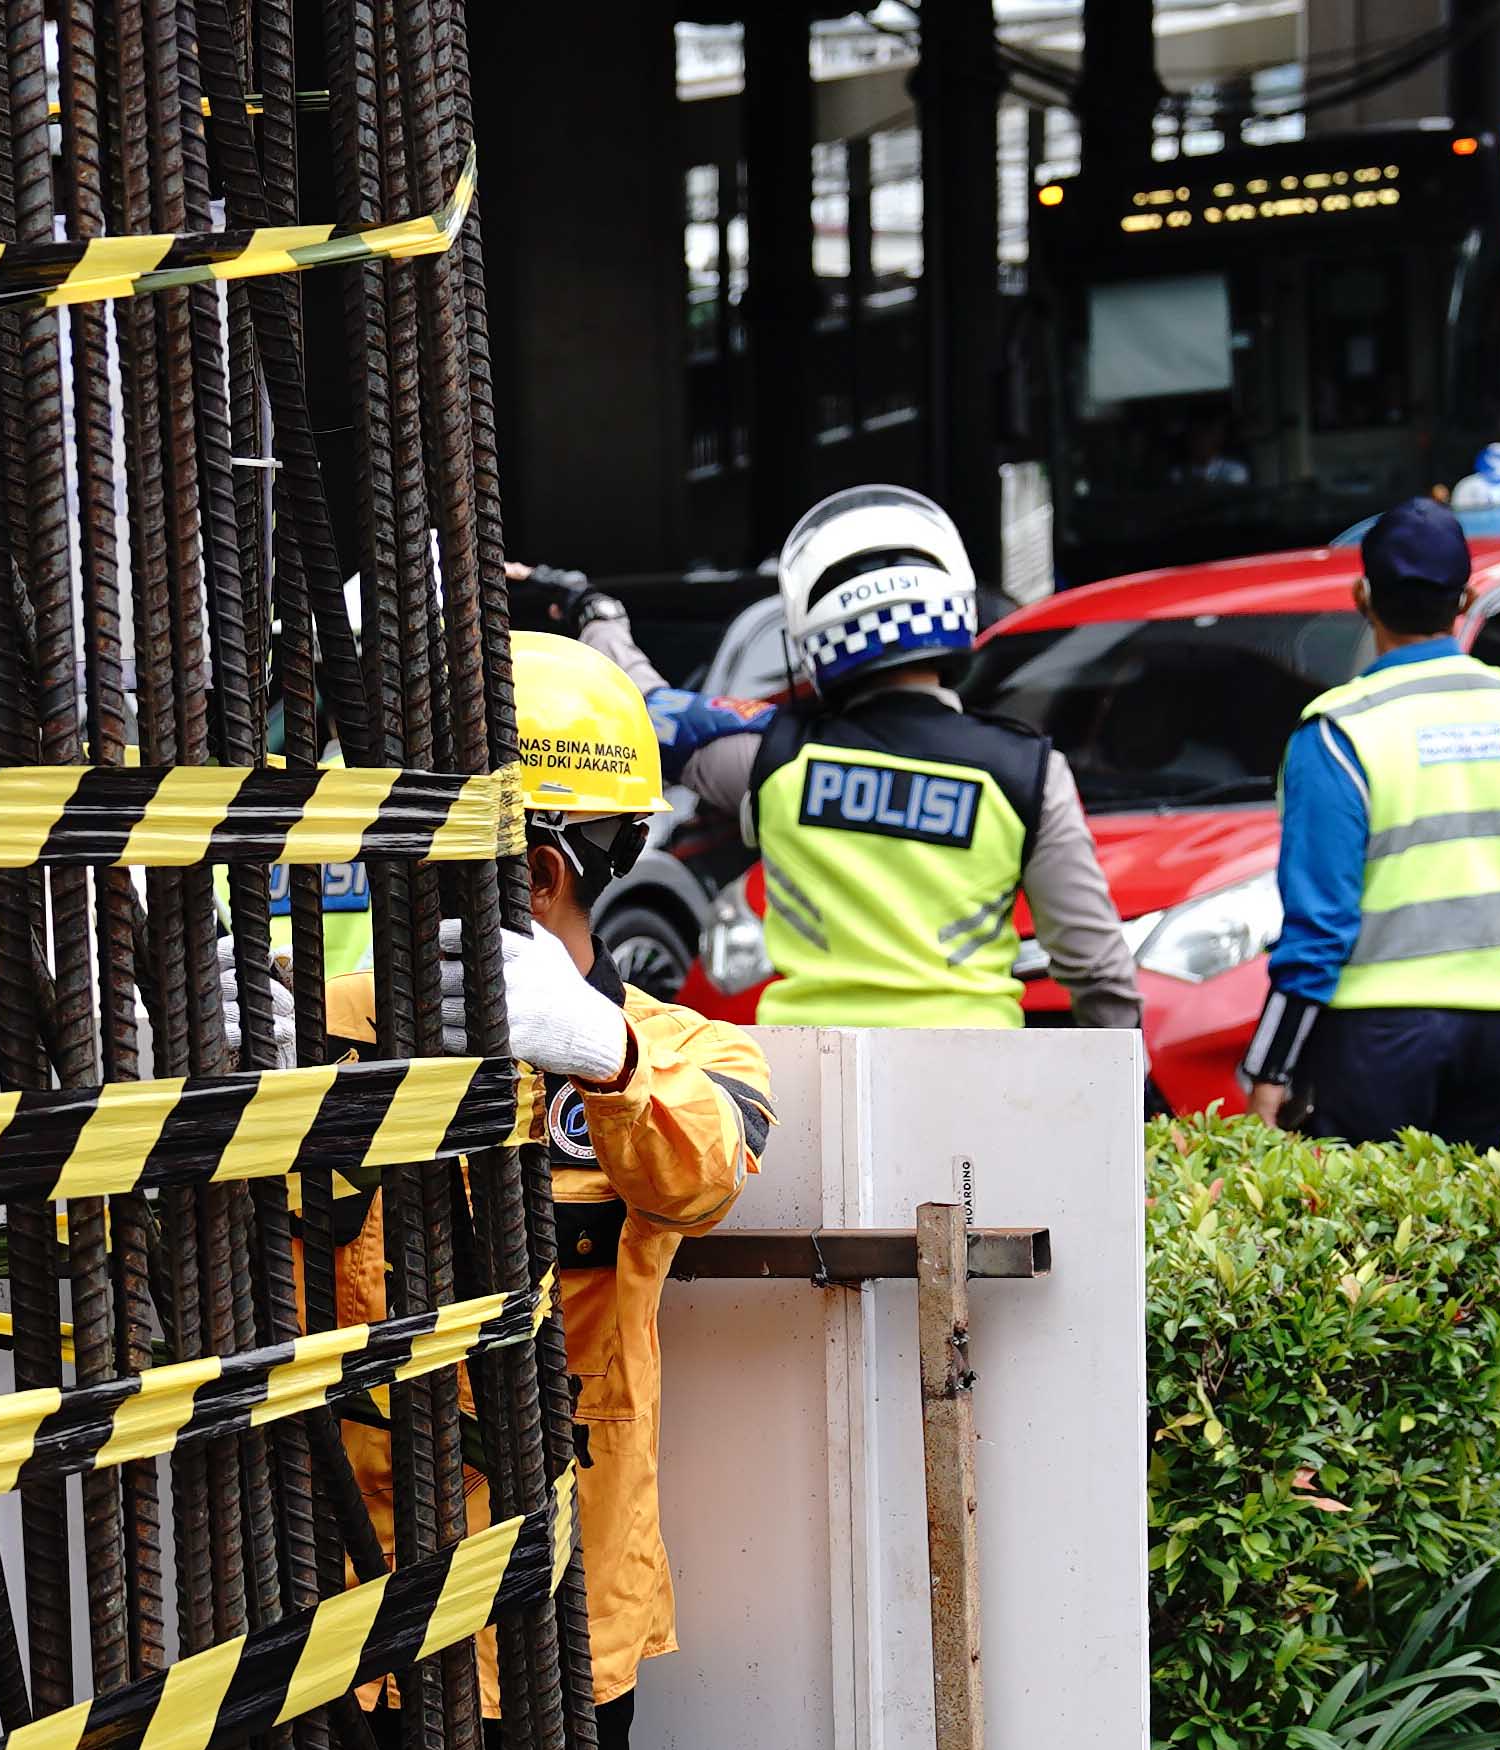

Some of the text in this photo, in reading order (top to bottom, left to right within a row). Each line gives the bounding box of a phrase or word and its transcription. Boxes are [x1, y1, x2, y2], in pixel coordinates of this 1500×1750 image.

[839, 575, 919, 608] POLISI
[519, 738, 637, 761] NAS BINA MARGA
[547, 754, 571, 769] DKI
[575, 757, 631, 775] JAKARTA
[805, 761, 976, 839] POLISI
[962, 1161, 973, 1225] HOARDING
